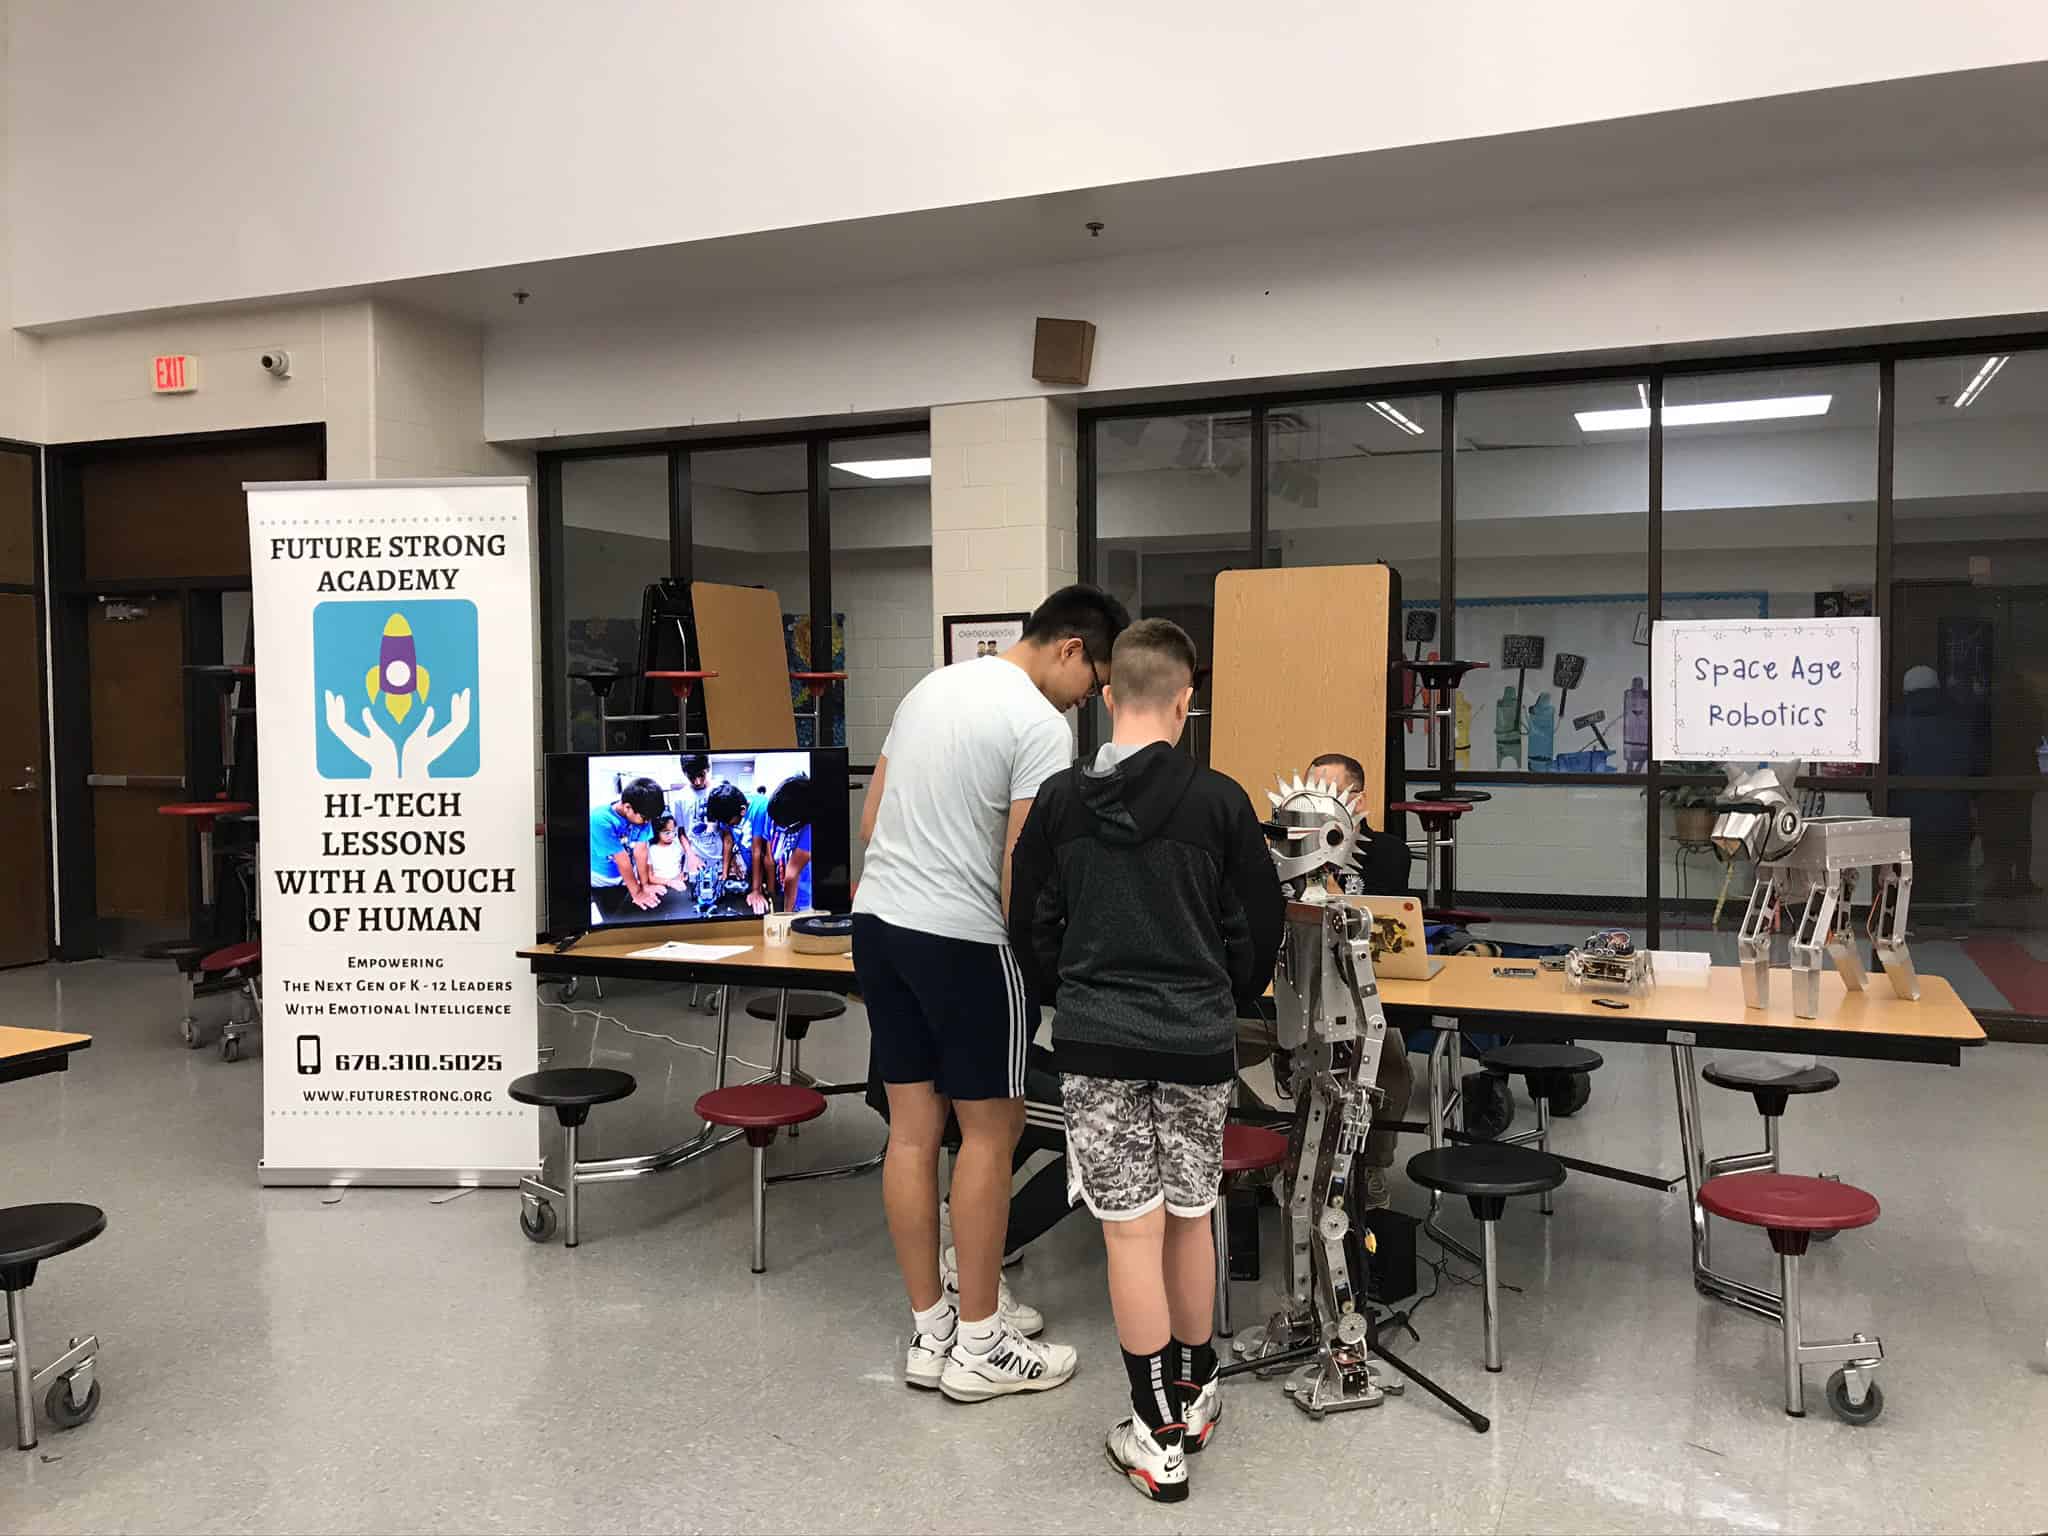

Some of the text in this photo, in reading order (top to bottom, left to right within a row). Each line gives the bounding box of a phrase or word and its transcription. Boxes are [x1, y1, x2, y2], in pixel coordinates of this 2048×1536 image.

[156, 356, 185, 389] EXIT
[271, 534, 506, 560] FUTURE STRONG
[317, 568, 459, 592] ACADEMY
[1694, 655, 1842, 687] Space Age
[1709, 702, 1827, 728] Robotics
[324, 793, 462, 818] HI-TECH
[321, 831, 465, 856] LESSONS
[274, 867, 517, 895] WITH A TOUCH
[308, 906, 482, 932] OF HUMAN
[347, 956, 444, 969] EMPOWERING
[282, 980, 311, 992] THE
[314, 979, 353, 992] NEXT
[356, 979, 385, 992] GEN
[451, 978, 513, 992] LEADERS
[285, 1002, 512, 1016] WITH EMOTIONAL INTELLIGENCE
[335, 1054, 503, 1072] 678.310.5025
[302, 1089, 493, 1102] WWW.FUTURESTRONG.ORG
